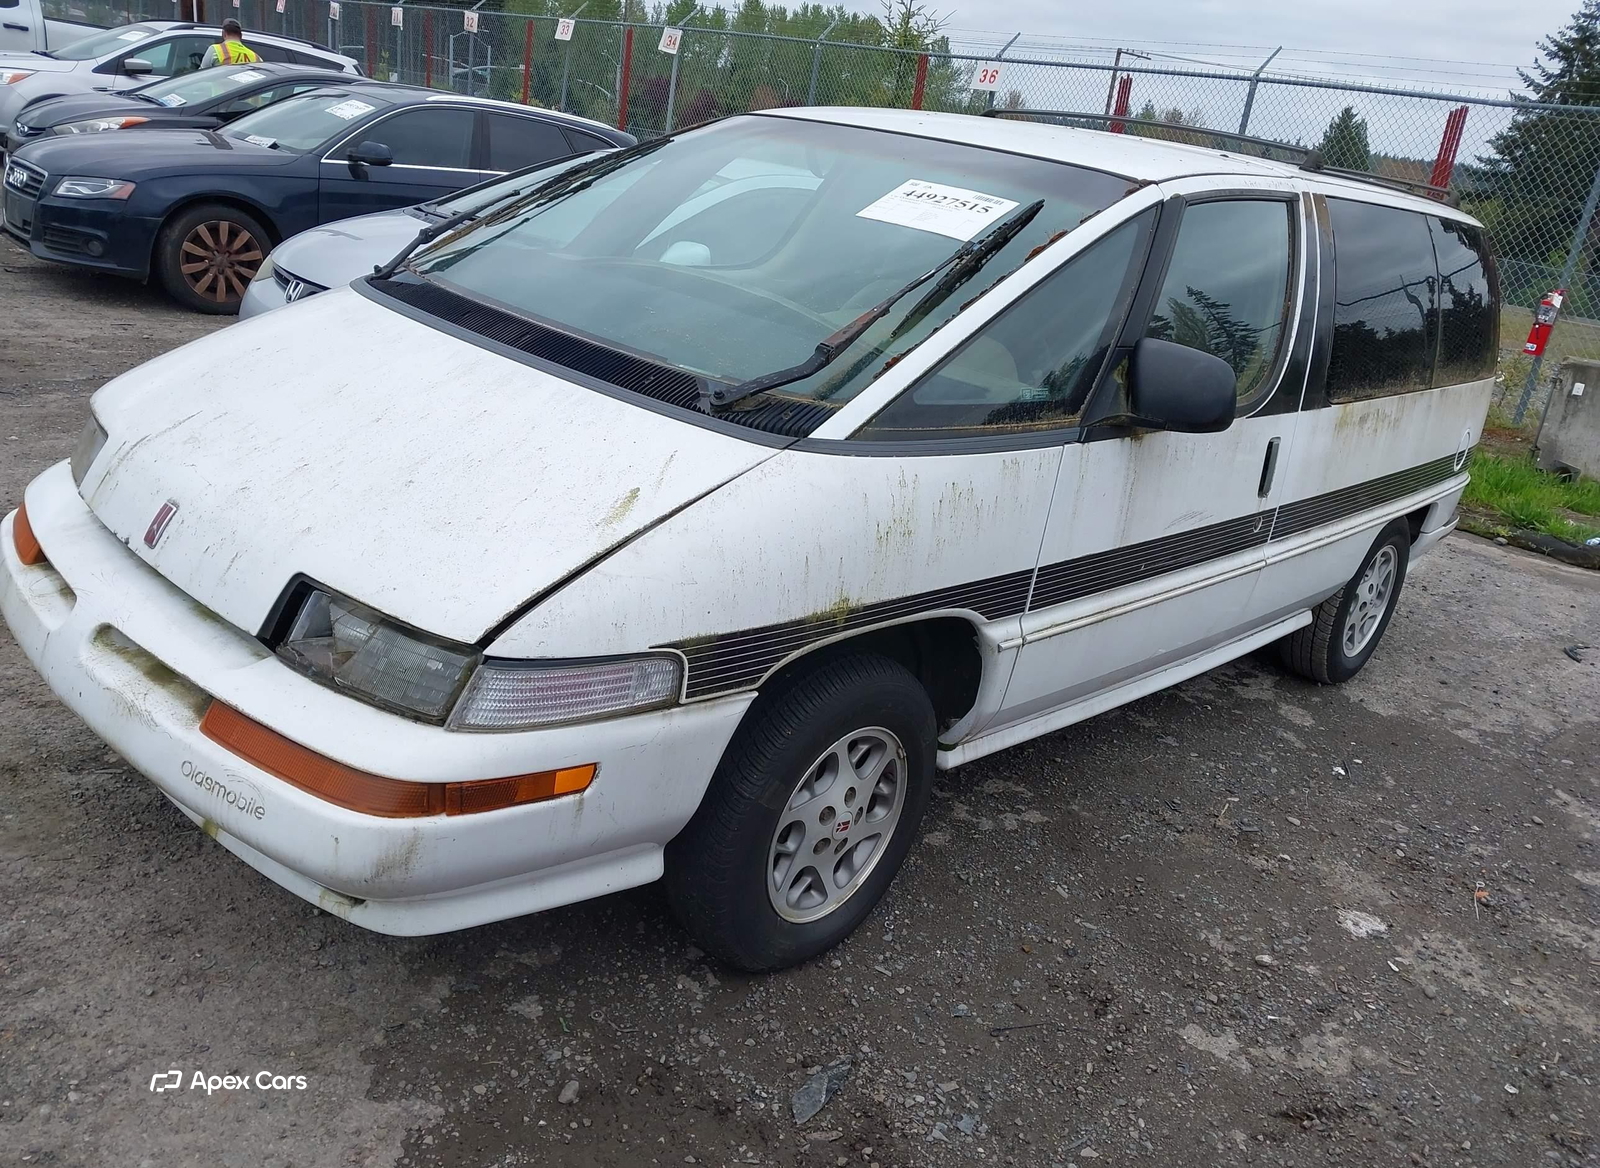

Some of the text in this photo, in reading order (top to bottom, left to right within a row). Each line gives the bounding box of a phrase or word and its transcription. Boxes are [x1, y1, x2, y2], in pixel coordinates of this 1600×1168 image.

[465, 16, 475, 28] 32
[560, 24, 570, 35] 33
[666, 34, 678, 48] 34
[979, 68, 999, 84] 36
[902, 189, 994, 214] 44927515
[181, 760, 266, 820] Oldsmobile
